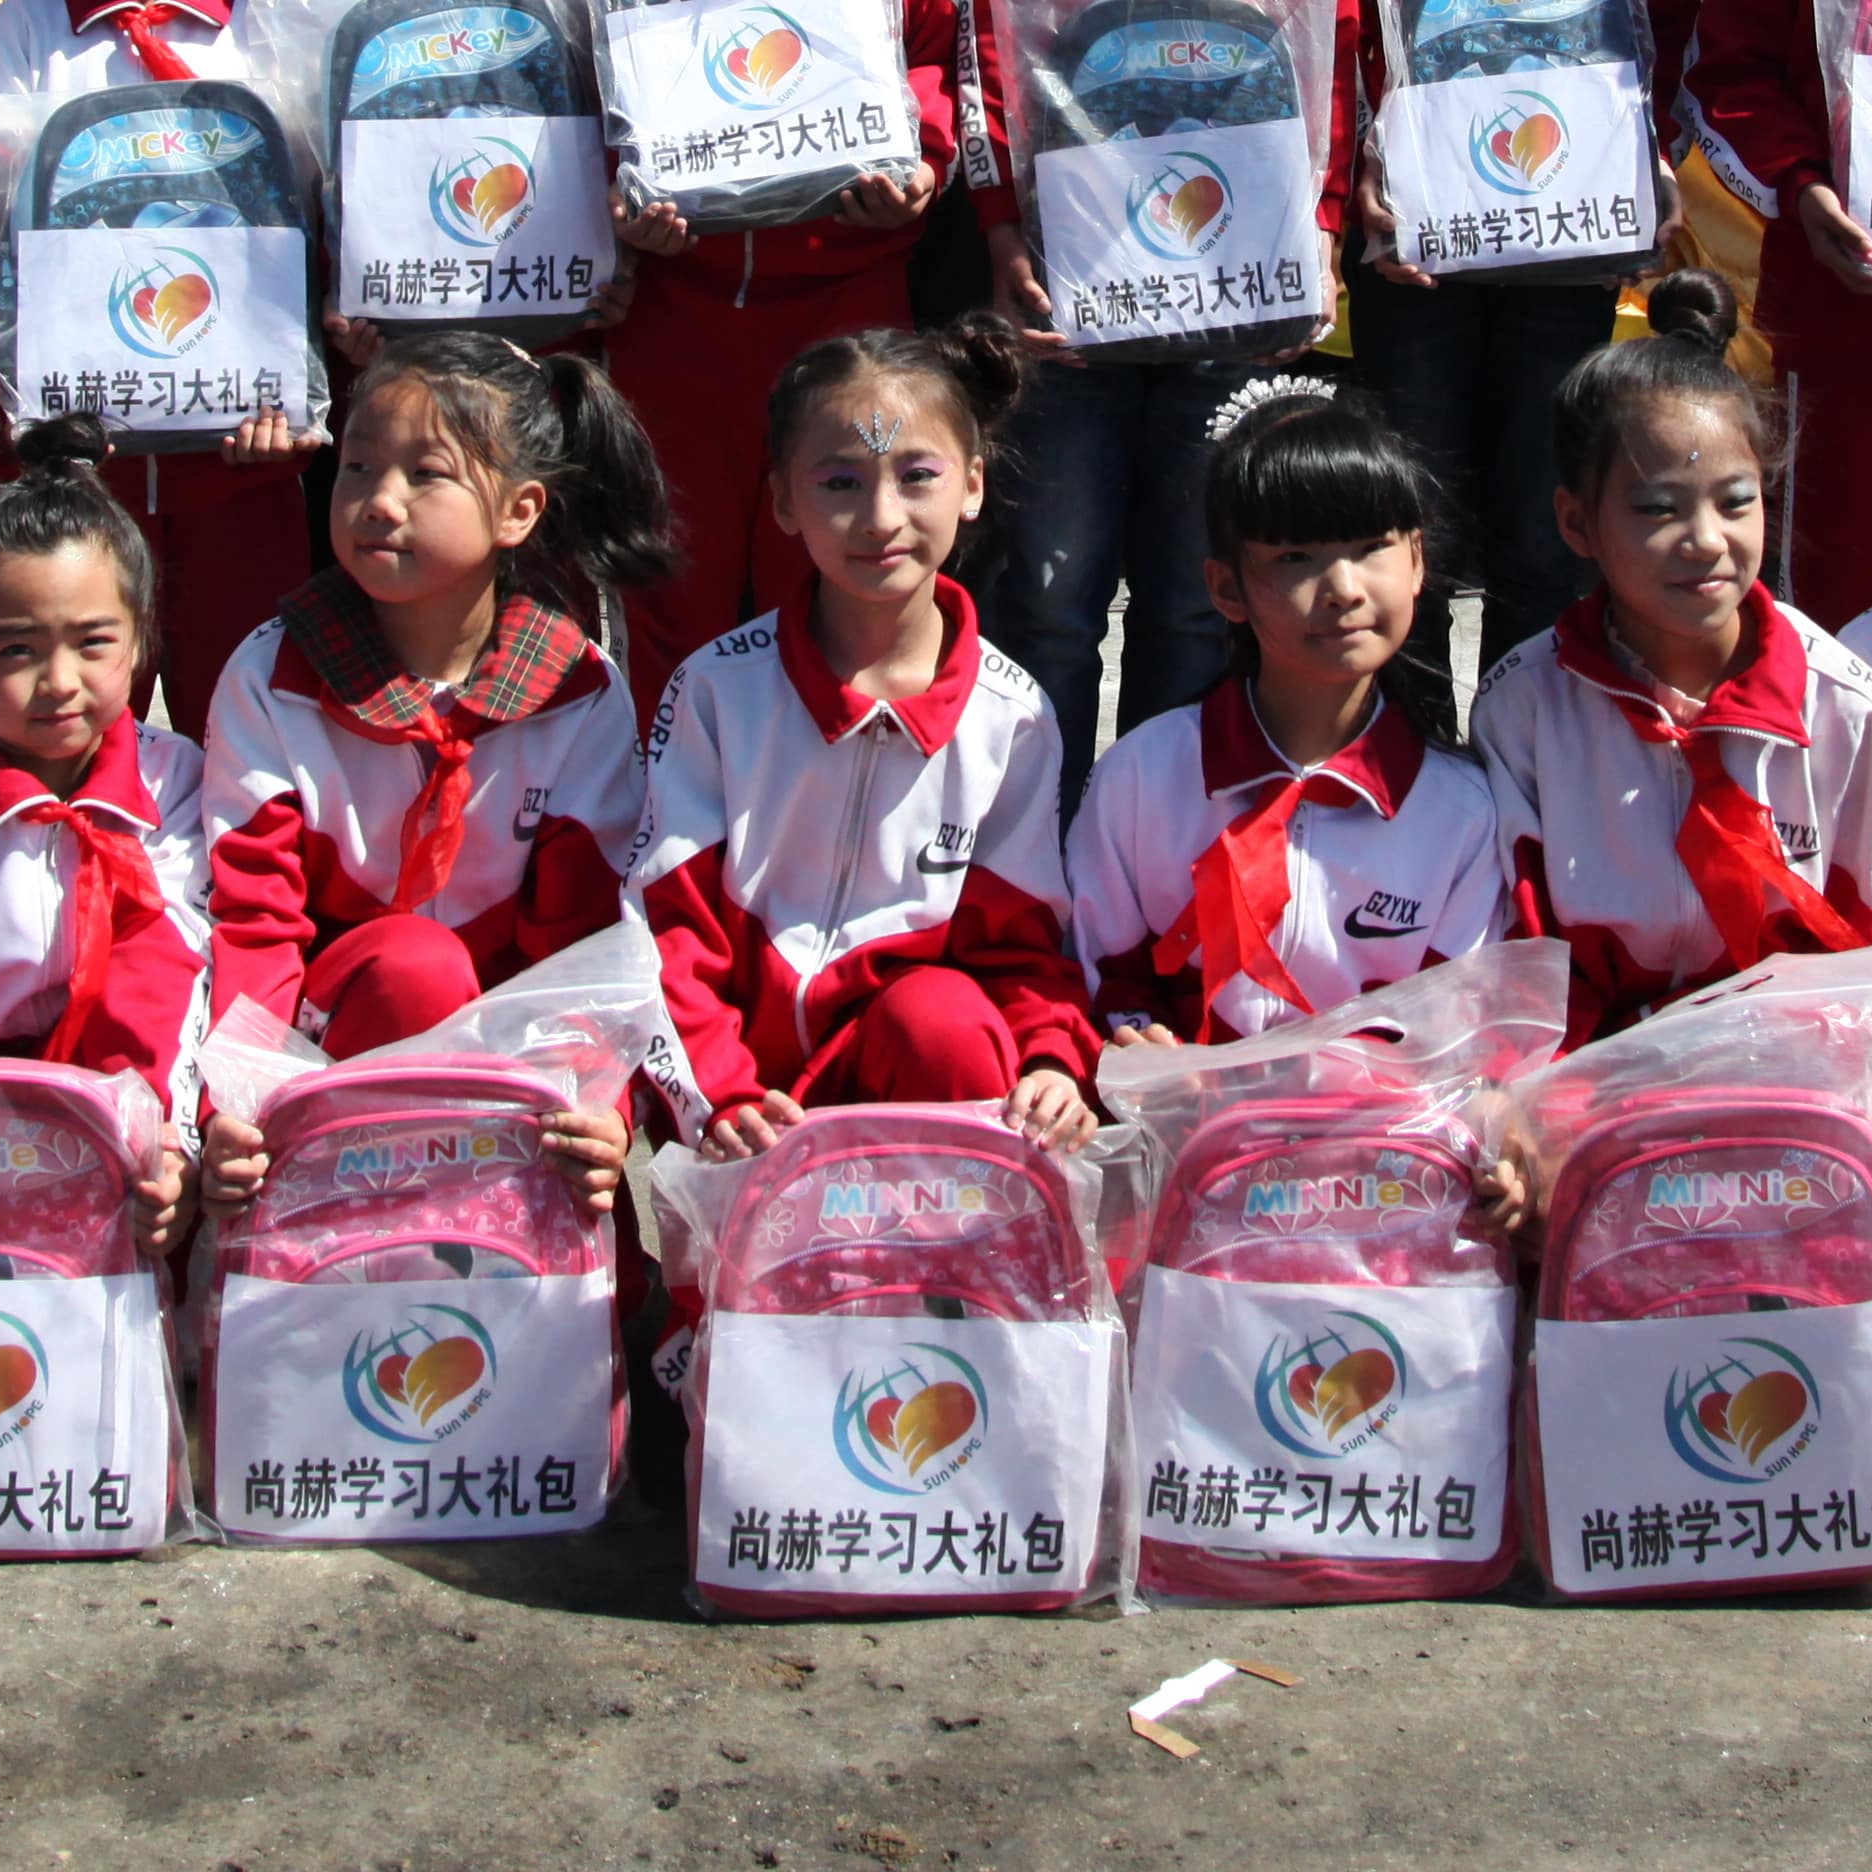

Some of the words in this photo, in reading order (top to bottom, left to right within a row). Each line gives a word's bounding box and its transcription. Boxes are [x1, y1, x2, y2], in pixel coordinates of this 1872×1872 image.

[956, 0, 976, 87] SPORT
[649, 101, 892, 178] 尚赫学习大礼包
[960, 92, 994, 188] SPORT
[1416, 193, 1641, 264] 尚赫学习大礼包
[360, 254, 594, 306] 尚赫学习大礼包
[1072, 256, 1307, 333] 尚赫学习大礼包
[714, 628, 778, 658] ORT
[981, 649, 1039, 694] ORT
[647, 665, 686, 765] SPORT
[1363, 890, 1423, 927] GZYXX
[646, 1035, 692, 1115] SPORT
[244, 1453, 579, 1520] 尚赫学习大礼包
[1145, 1458, 1478, 1542] 尚赫学习大礼包
[728, 1505, 1066, 1577] 尚赫学习大礼包
